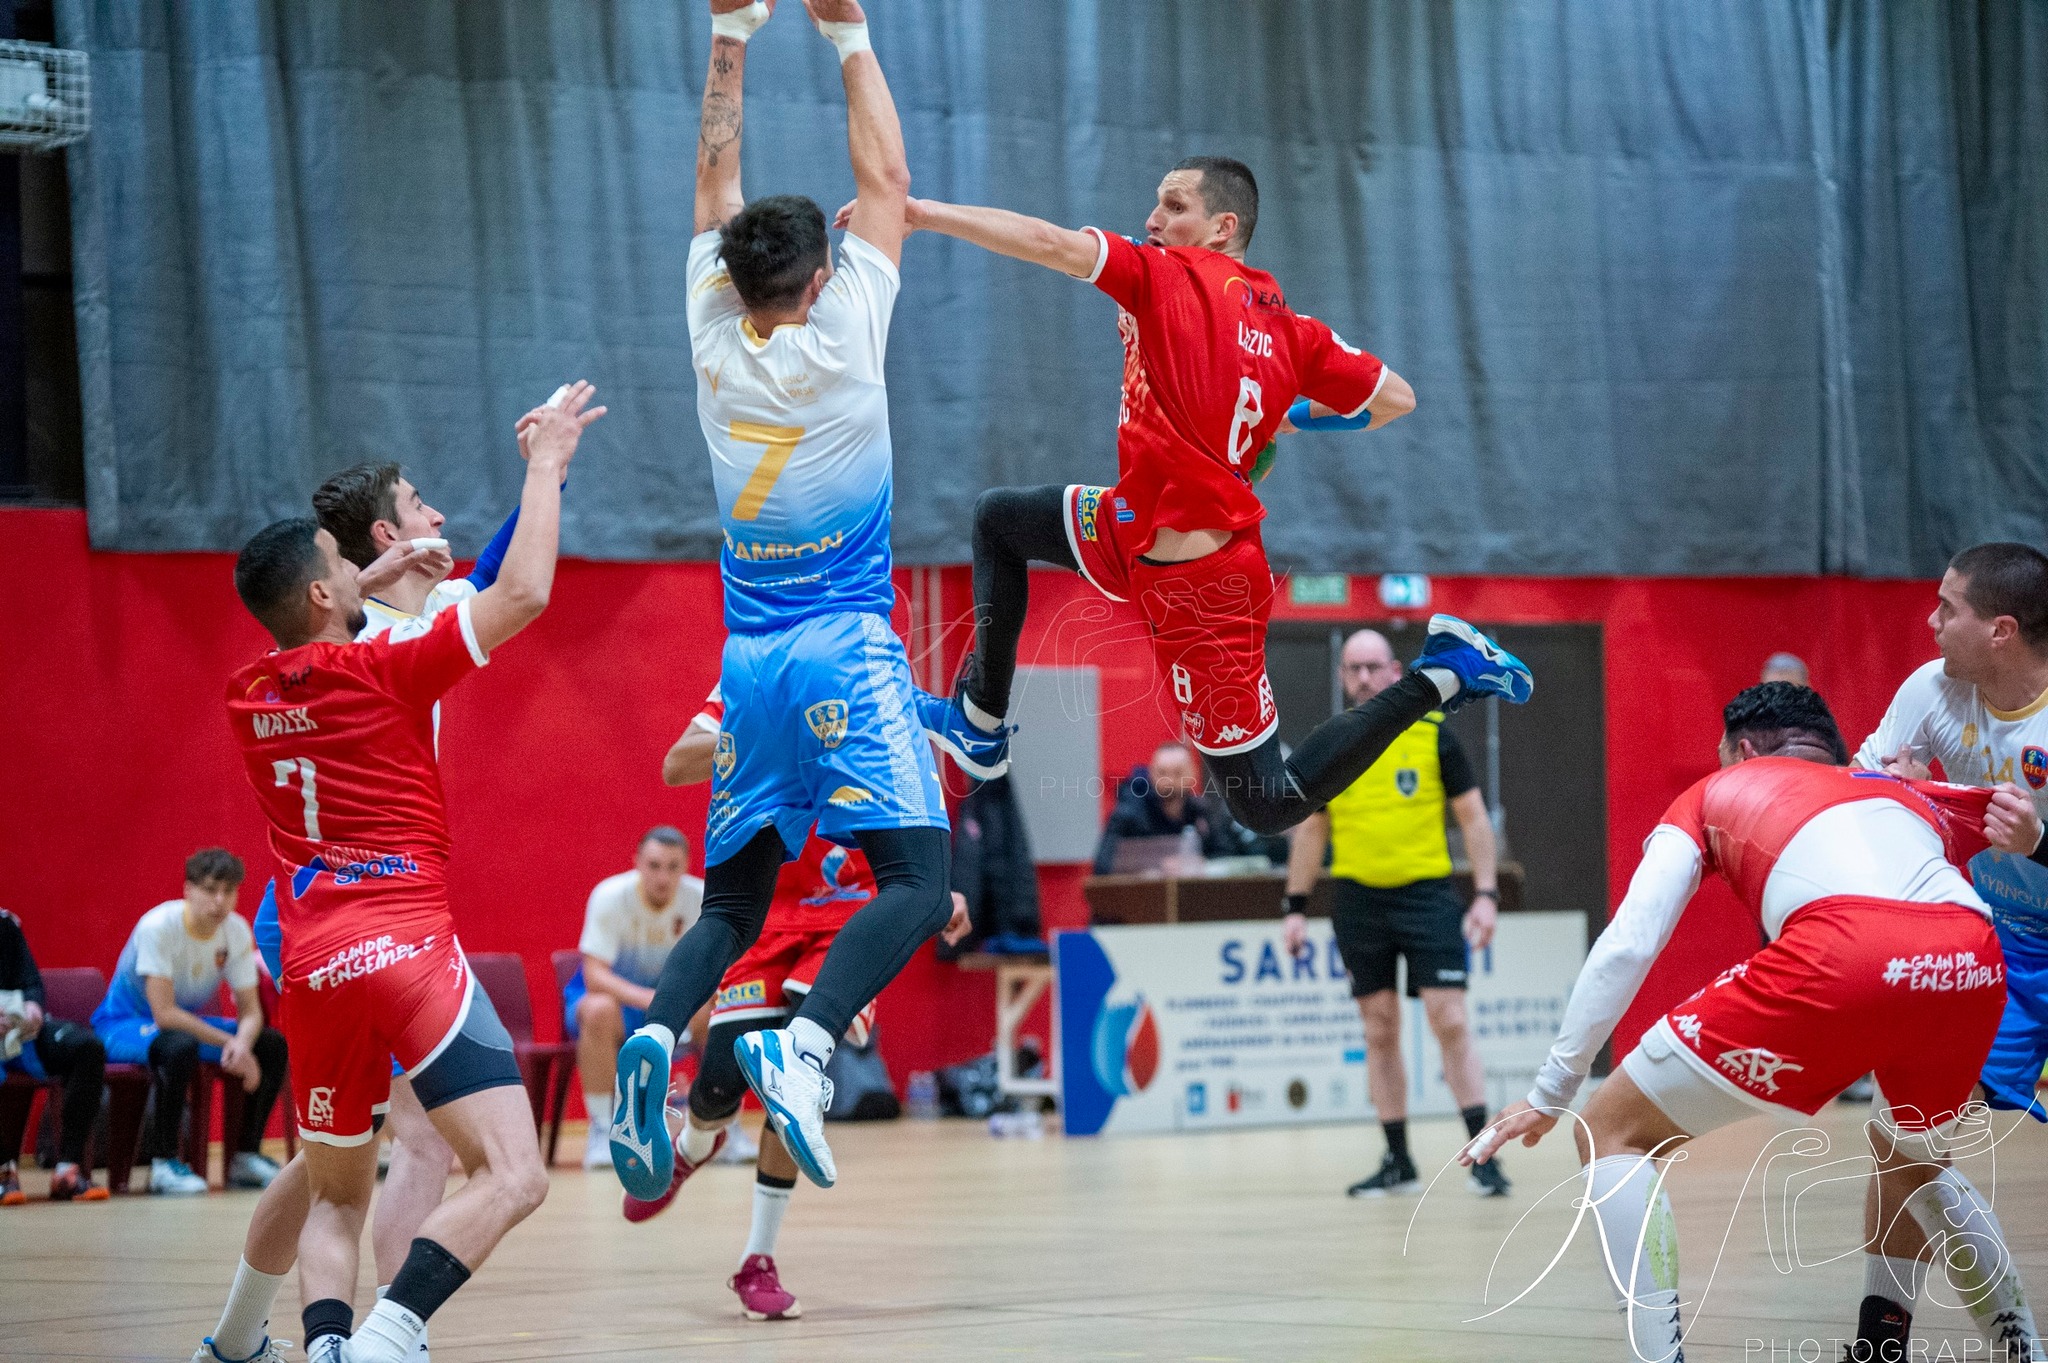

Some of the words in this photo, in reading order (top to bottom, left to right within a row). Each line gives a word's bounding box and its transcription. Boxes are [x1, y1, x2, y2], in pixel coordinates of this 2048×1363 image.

[729, 420, 806, 521] 7
[278, 665, 313, 691] EAP
[1172, 663, 1193, 704] 8
[253, 706, 319, 739] MALEK
[271, 756, 322, 842] 7
